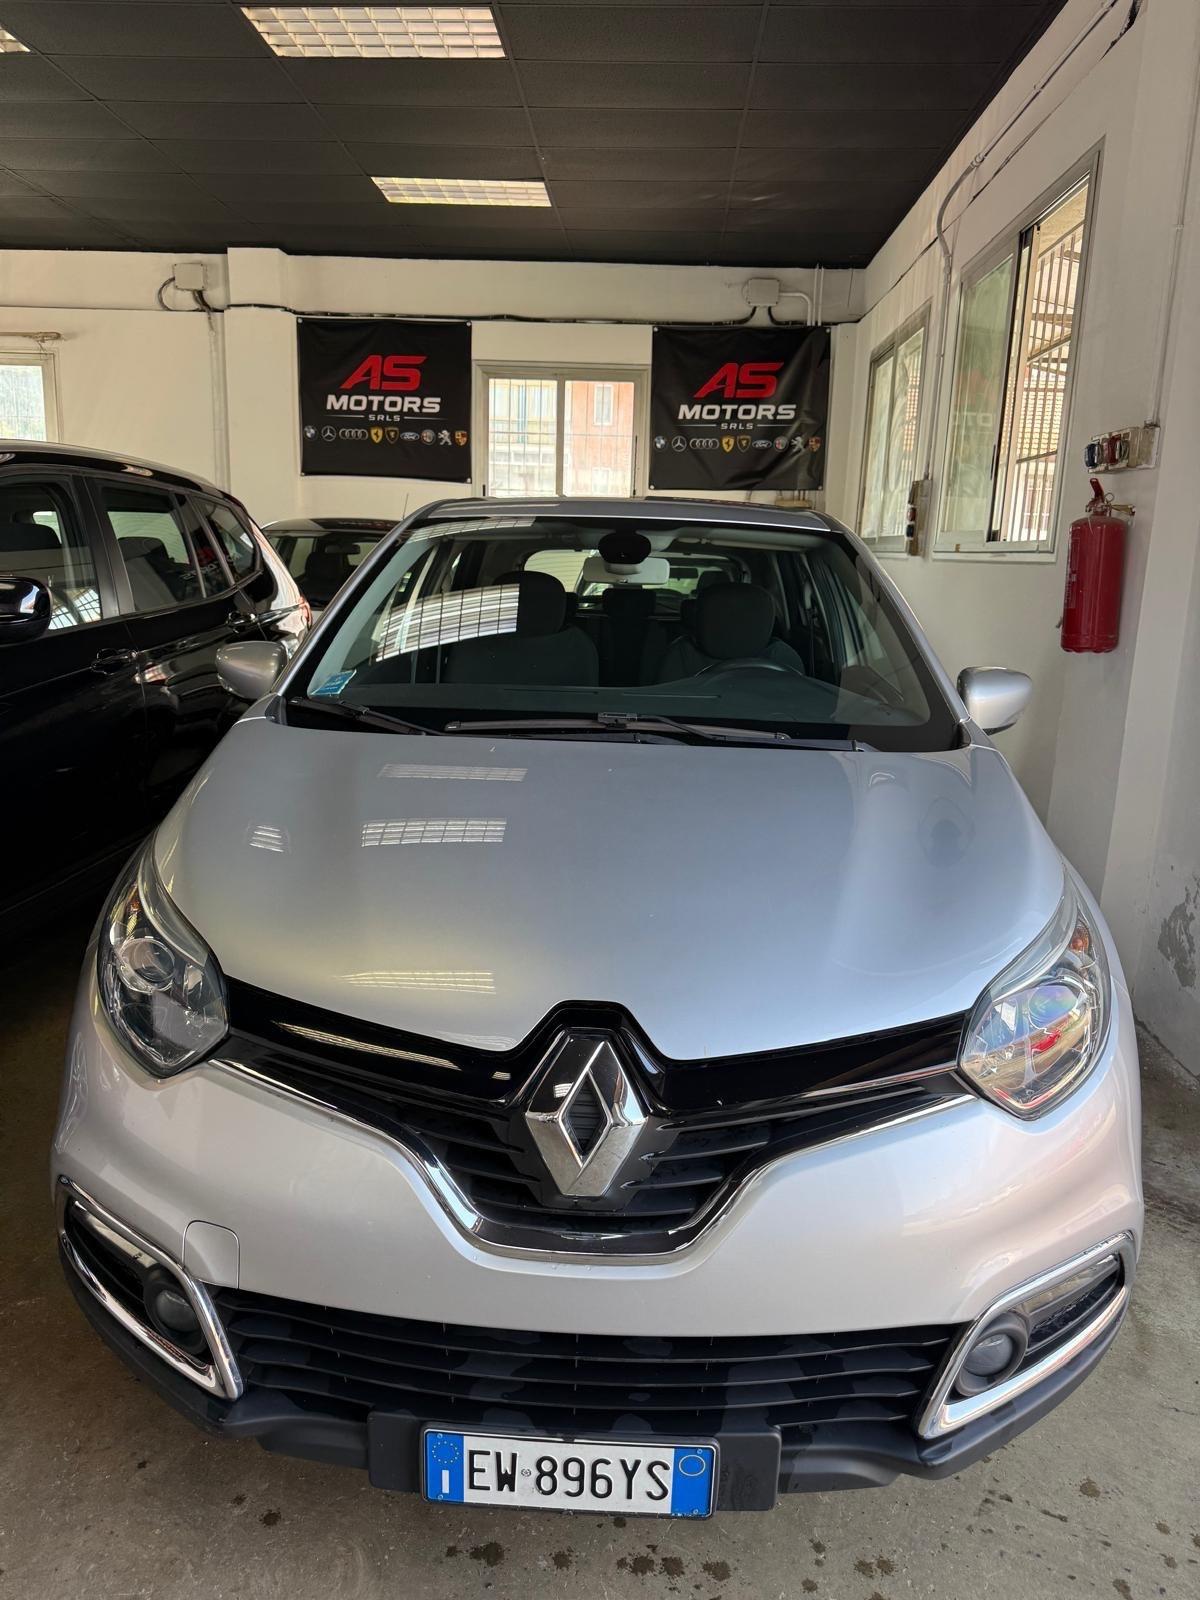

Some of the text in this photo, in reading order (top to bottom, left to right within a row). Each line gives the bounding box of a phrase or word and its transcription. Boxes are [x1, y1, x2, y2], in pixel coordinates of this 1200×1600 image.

[340, 355, 427, 391] AS
[693, 362, 784, 398] AS
[326, 394, 442, 413] MOTORS
[678, 404, 797, 420] MOTORS
[368, 414, 401, 422] SRLS
[442, 1469, 450, 1494] I
[468, 1449, 671, 1501] EW 896YS
